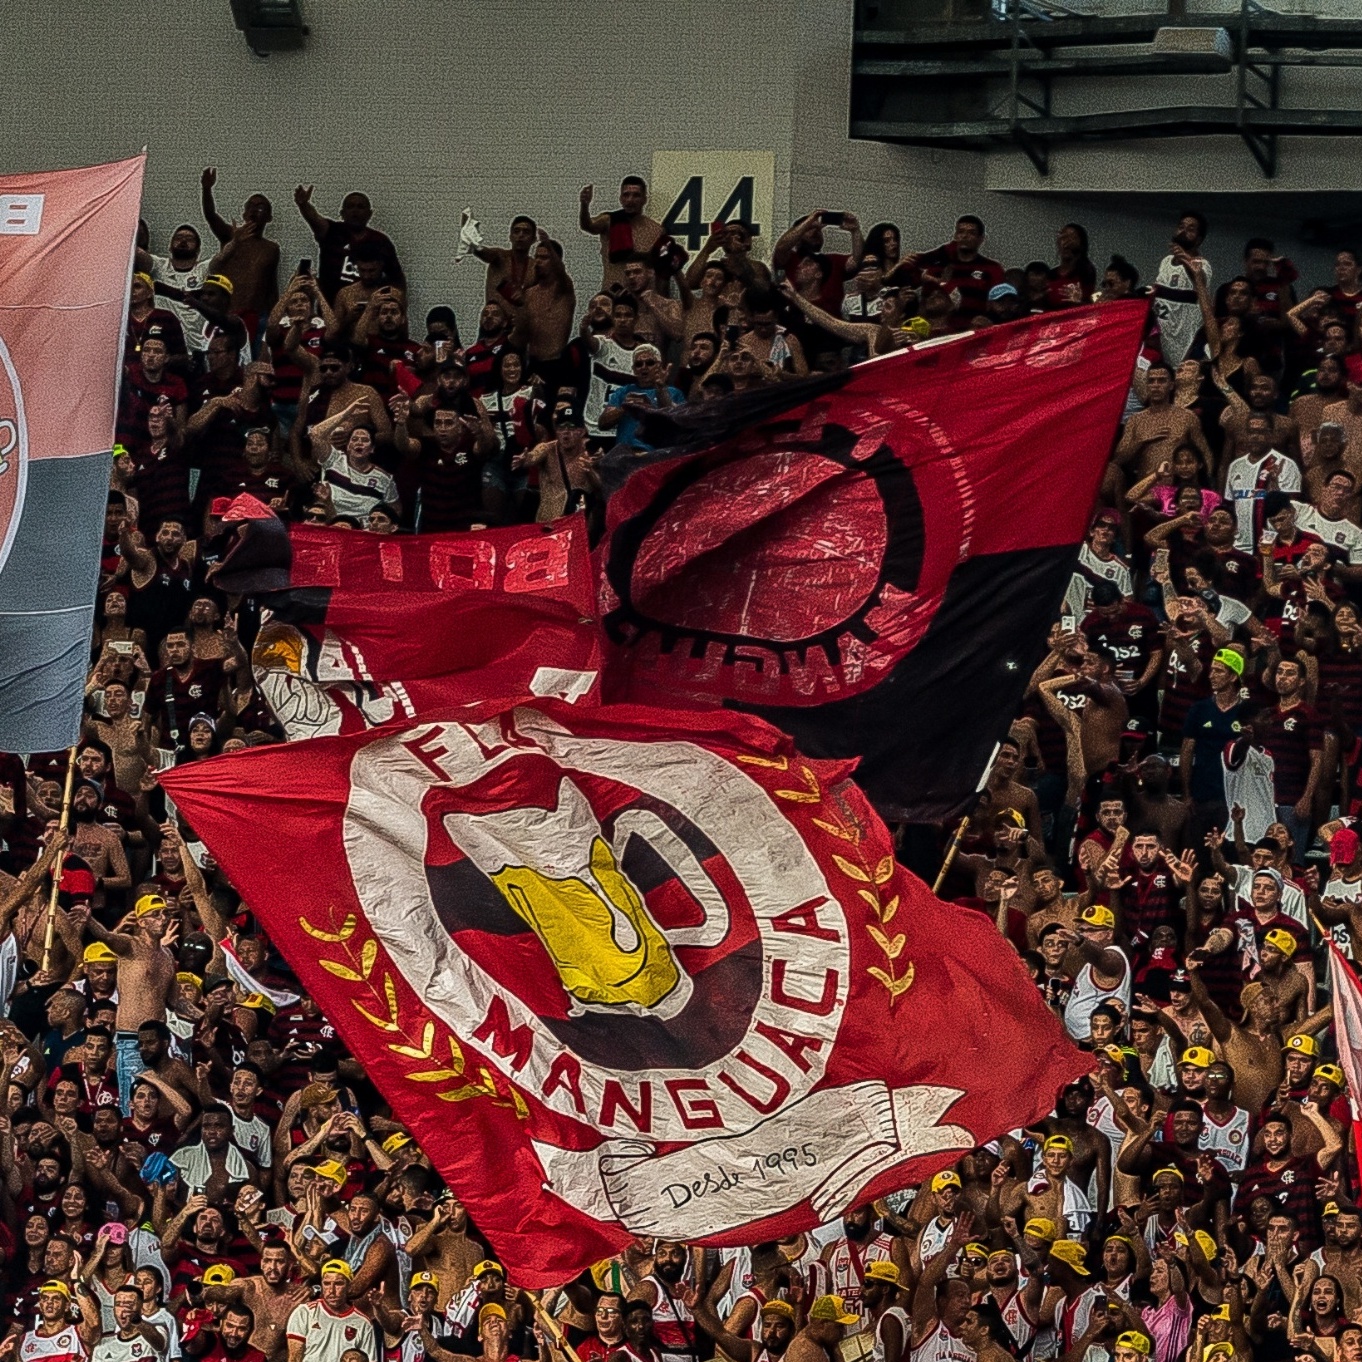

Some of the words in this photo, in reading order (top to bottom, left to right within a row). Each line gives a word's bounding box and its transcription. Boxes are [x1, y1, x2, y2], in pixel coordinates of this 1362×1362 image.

[662, 175, 760, 250] 44
[661, 1166, 743, 1208] Desde
[753, 1142, 817, 1180] 1995
